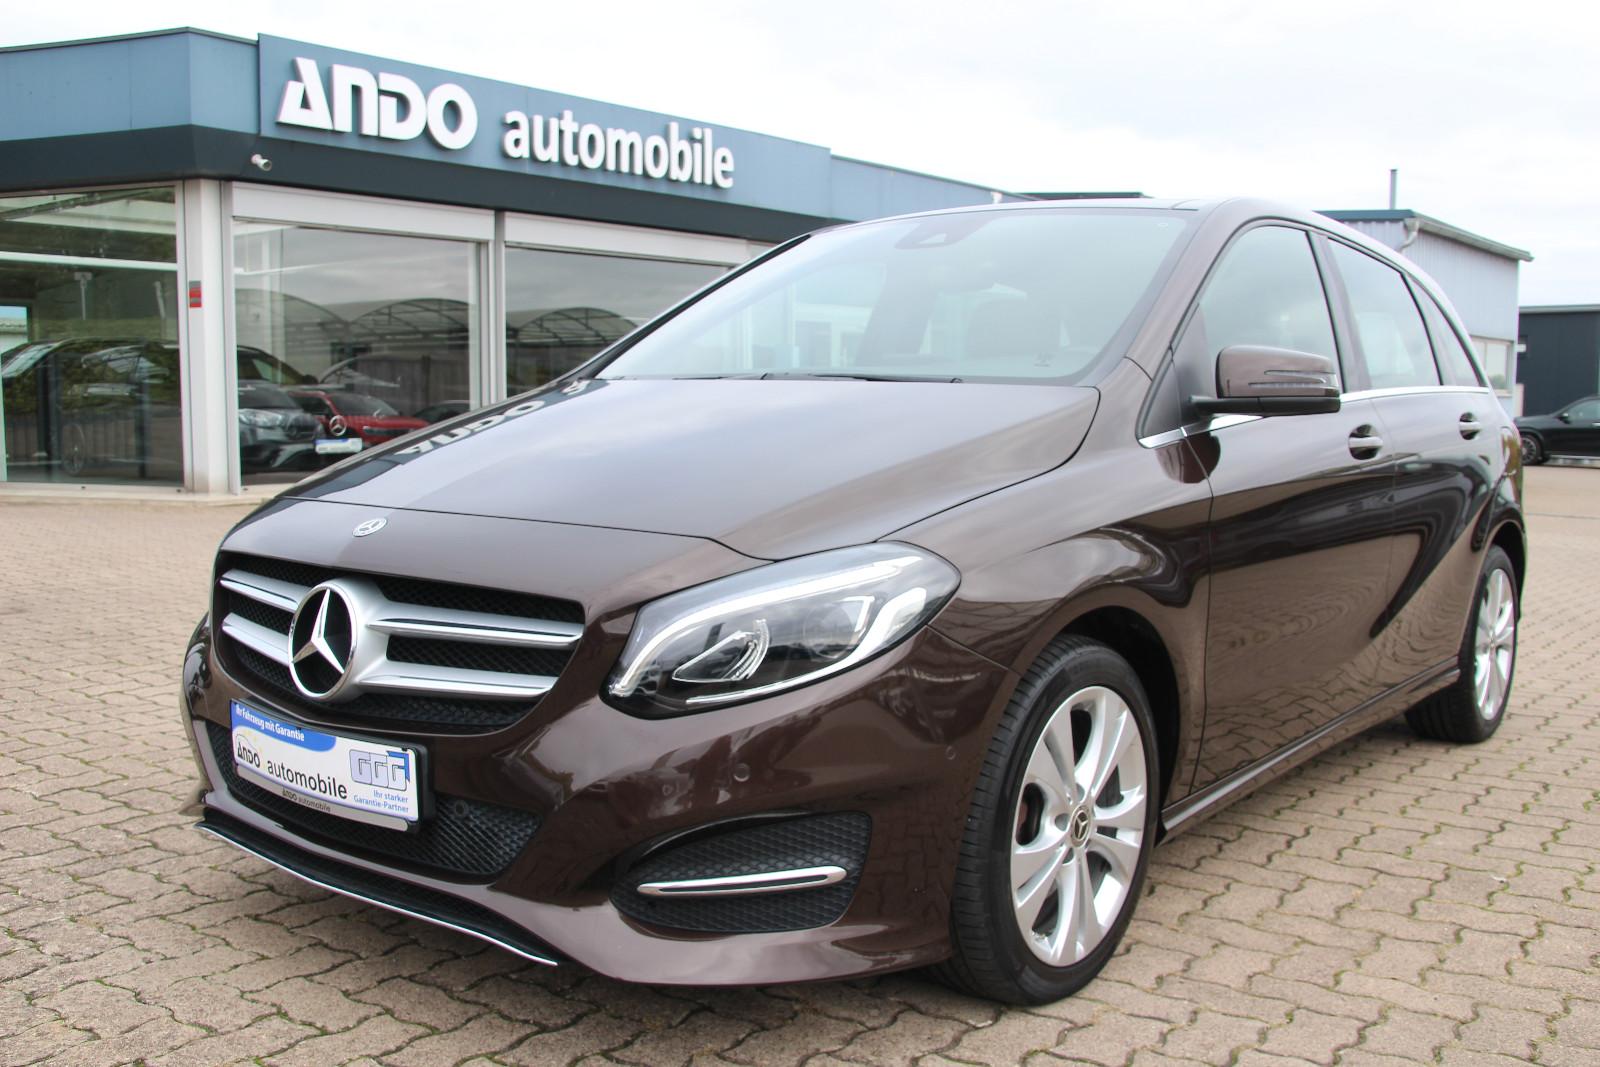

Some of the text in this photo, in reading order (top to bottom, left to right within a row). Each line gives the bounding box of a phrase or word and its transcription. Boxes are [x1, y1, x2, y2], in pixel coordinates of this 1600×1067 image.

[276, 56, 735, 189] ANDO automobile
[242, 708, 265, 730] Fahrzeug
[265, 720, 275, 733] mit
[275, 723, 305, 742] Garantie
[267, 760, 347, 800] automobile
[373, 789, 409, 803] Ihr starker
[353, 794, 409, 813] Garantie-Partner
